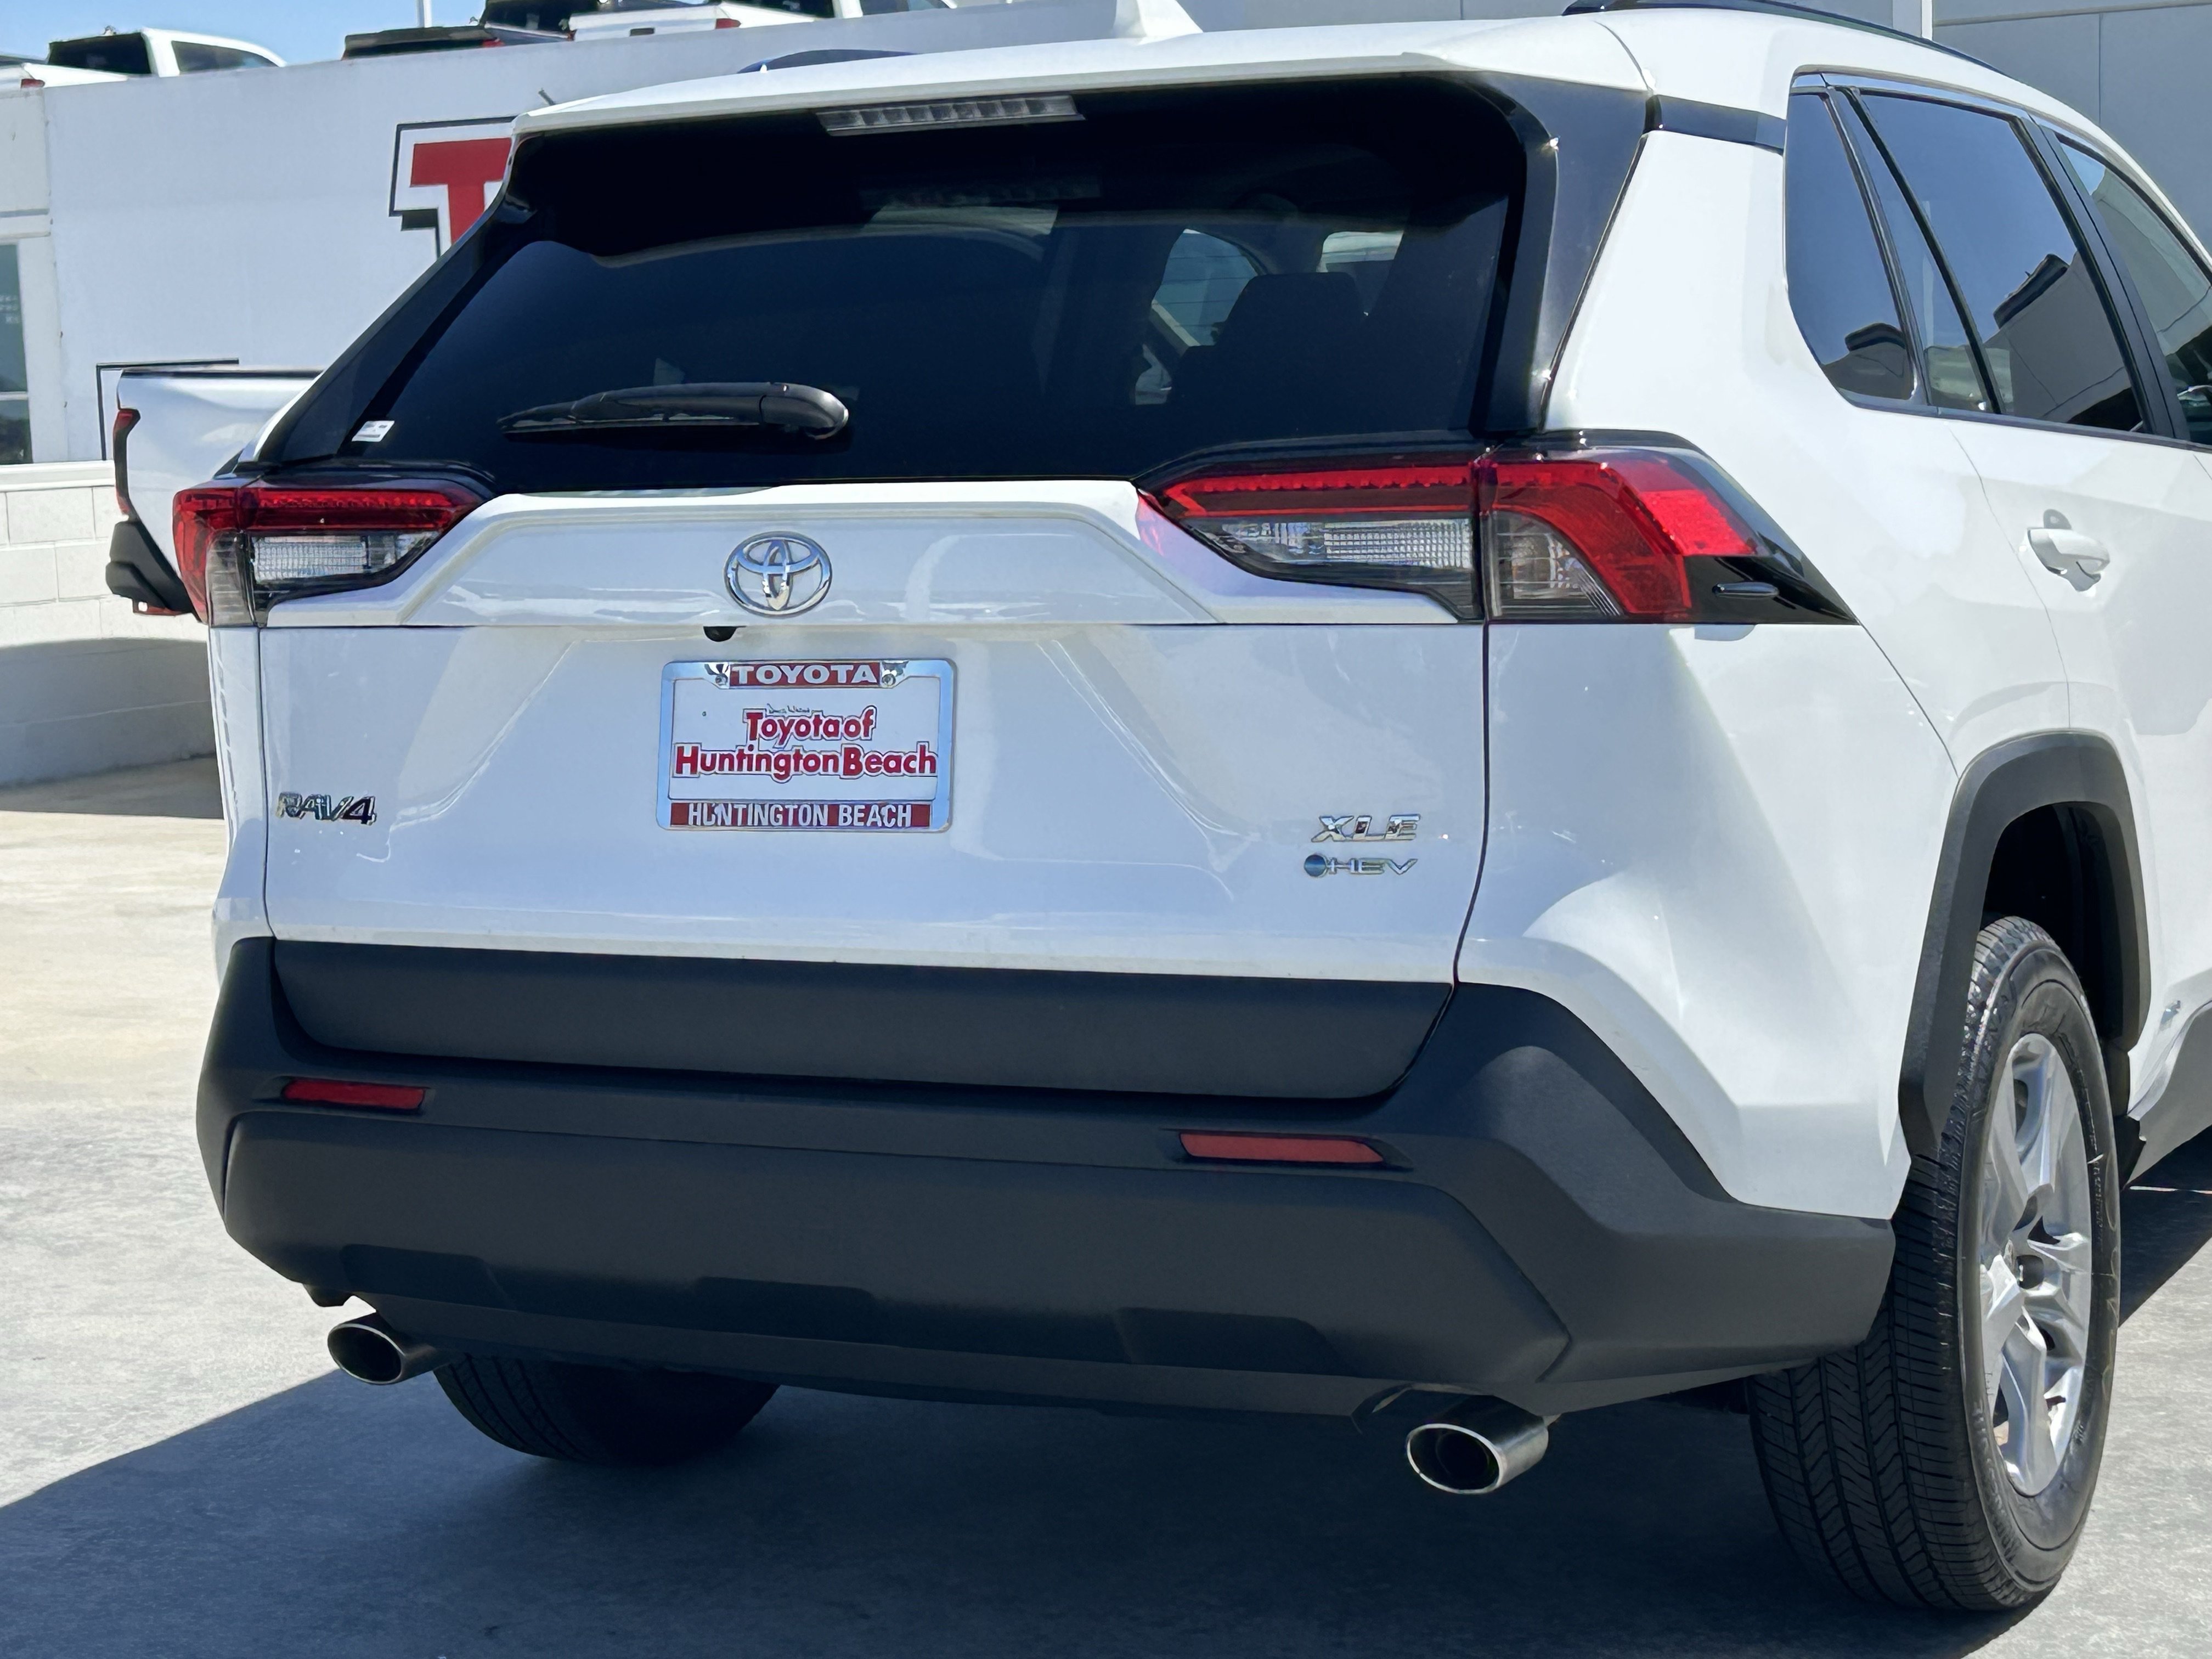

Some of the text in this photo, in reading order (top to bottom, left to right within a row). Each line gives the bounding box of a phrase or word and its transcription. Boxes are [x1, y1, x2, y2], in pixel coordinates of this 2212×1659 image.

[733, 664, 878, 684] TOYOTA
[746, 712, 842, 746] Toyota
[676, 745, 936, 780] Huntington Beach
[276, 792, 377, 825] RAV4
[689, 803, 911, 827] HUNTINGTON BEACH
[1311, 814, 1420, 842] XLE
[1330, 857, 1418, 874] HEV
